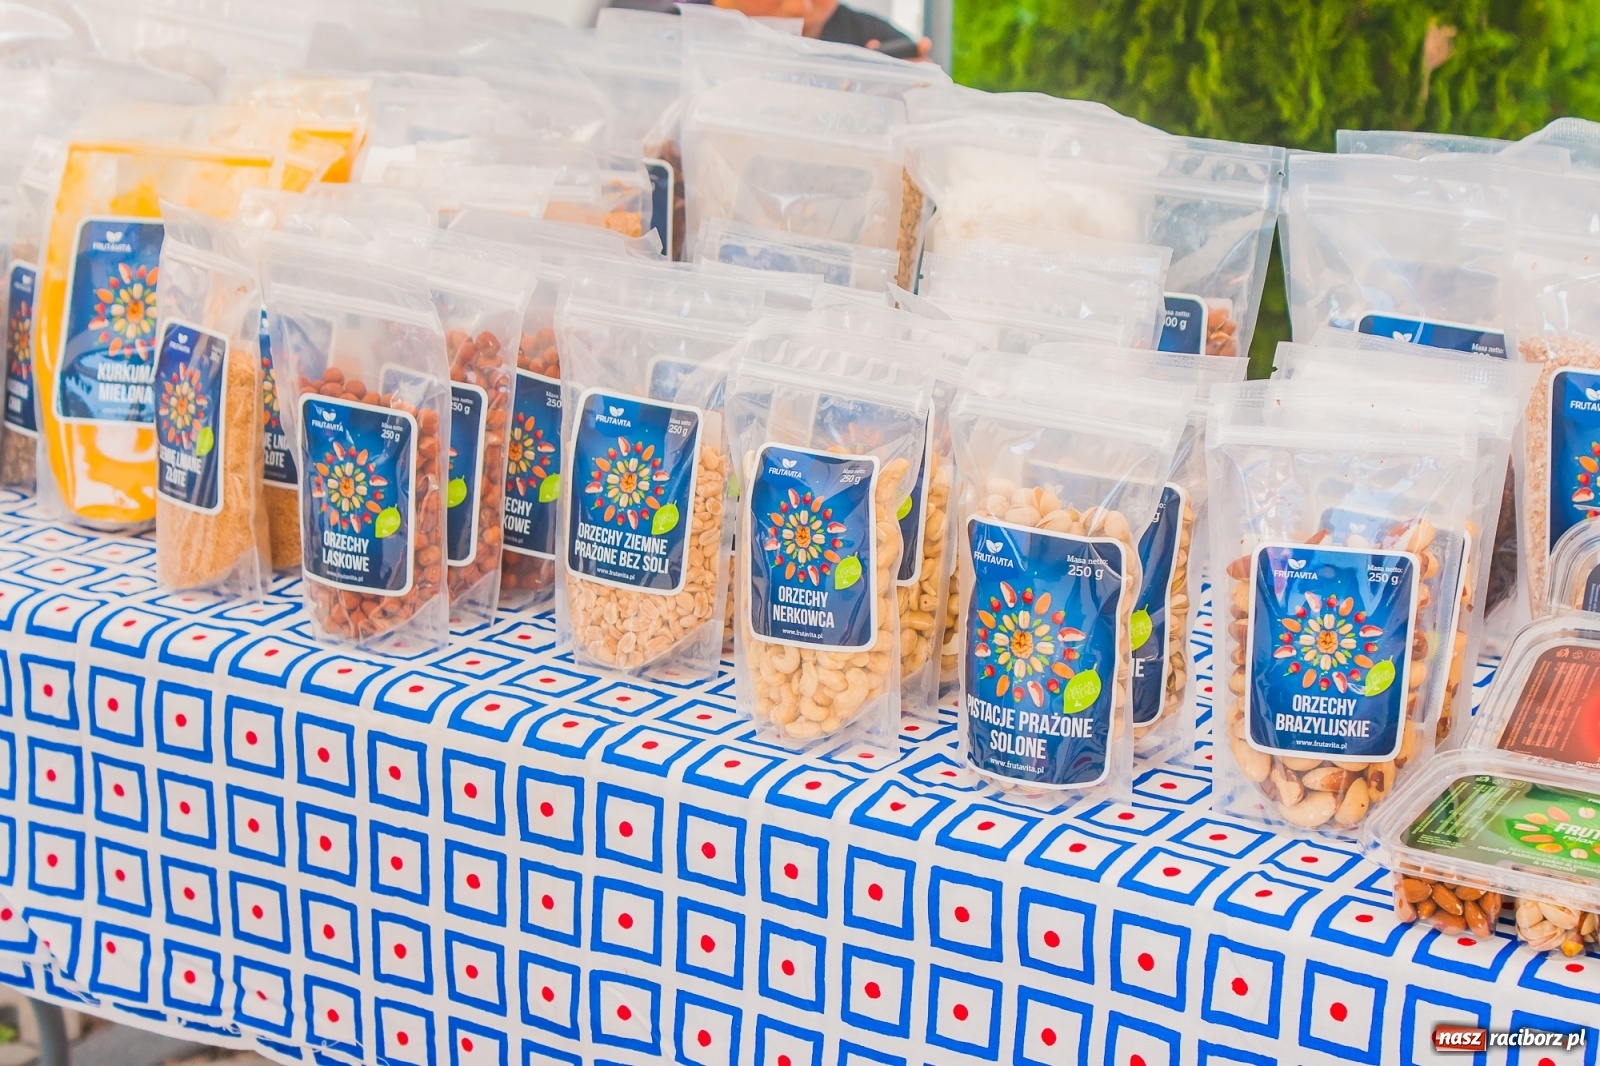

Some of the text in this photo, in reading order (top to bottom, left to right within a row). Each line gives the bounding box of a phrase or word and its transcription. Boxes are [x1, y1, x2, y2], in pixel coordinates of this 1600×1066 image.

[1165, 316, 1188, 331] 00 g
[98, 382, 153, 404] MIELONA
[451, 402, 470, 415] 50 g
[546, 398, 562, 408] 250
[312, 420, 344, 432] FRUTAVITA
[596, 414, 632, 428] FRUTAVITA
[381, 429, 400, 442] 250 g
[668, 424, 688, 436] 250 g
[264, 450, 285, 468] ŁOTE
[768, 467, 802, 478] FRUTAVITA
[840, 474, 861, 485] 250 g
[504, 496, 532, 517] ECHY
[323, 530, 369, 554] ORZECHY
[578, 522, 668, 555] ORZECHY ZIEMNE
[322, 548, 369, 572] LASKOWE
[574, 540, 669, 574] PRAŻONE BEZ SOLI
[974, 551, 1014, 568] FRUTAVITA
[1066, 554, 1086, 564] Masa
[597, 567, 636, 580] www.frutavita.pl
[1068, 564, 1104, 580] 250 g
[1274, 570, 1318, 580] FRUTAVITA
[1368, 572, 1399, 585] 250 g
[778, 585, 828, 608] ORZECHY
[773, 604, 835, 628] NERKOWCA
[782, 629, 823, 639] www.frutavita.pl
[1292, 694, 1357, 716] ORZECHY
[967, 694, 1094, 738] PISTACJE PRAŻONE
[1276, 713, 1370, 738] BRAZYLIJSKIE
[990, 729, 1047, 759] SOLONE
[1296, 740, 1347, 750] www.frutavita.pl
[990, 758, 1044, 774] www.frutavita.pl
[1562, 834, 1596, 845] relax
